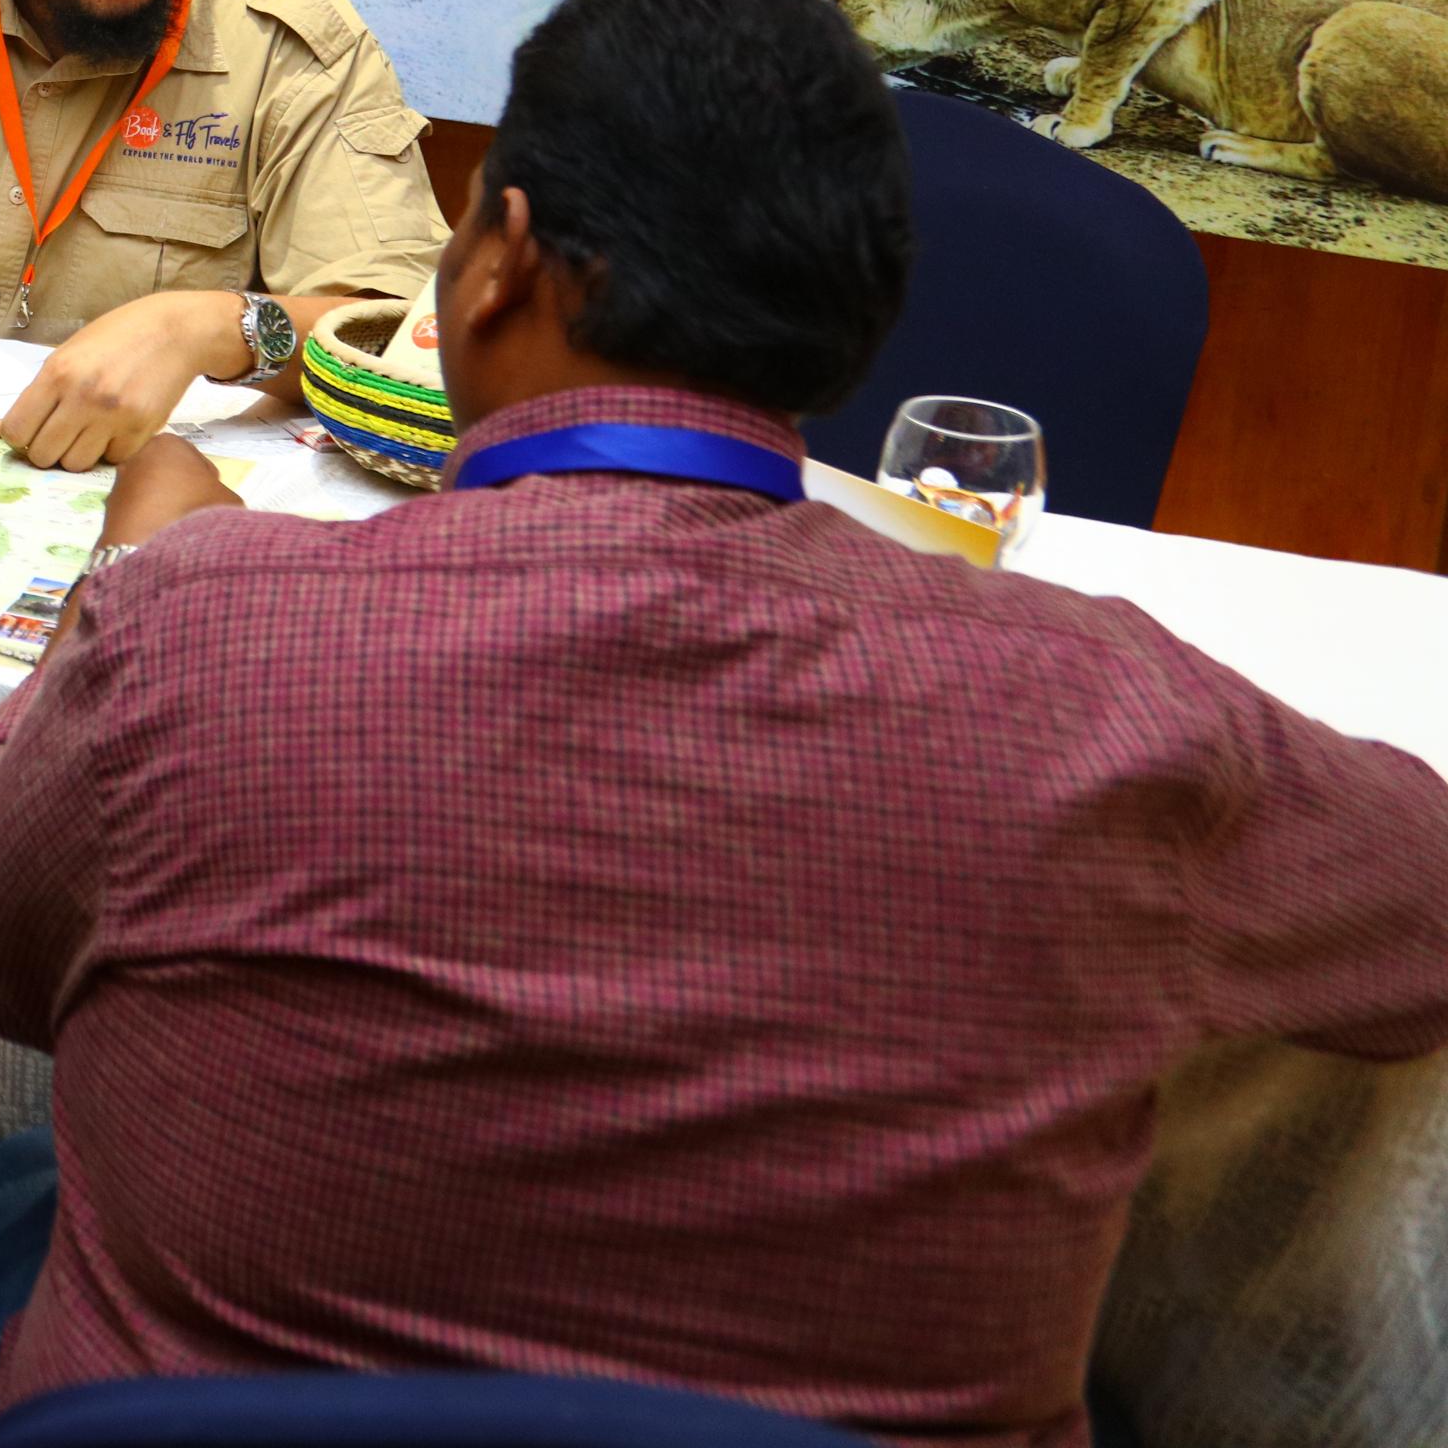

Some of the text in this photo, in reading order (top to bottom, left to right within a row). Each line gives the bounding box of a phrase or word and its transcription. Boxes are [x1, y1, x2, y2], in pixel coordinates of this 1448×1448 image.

[124, 115, 159, 140] Book
[175, 118, 198, 149] Fly
[199, 124, 241, 151] Travels
